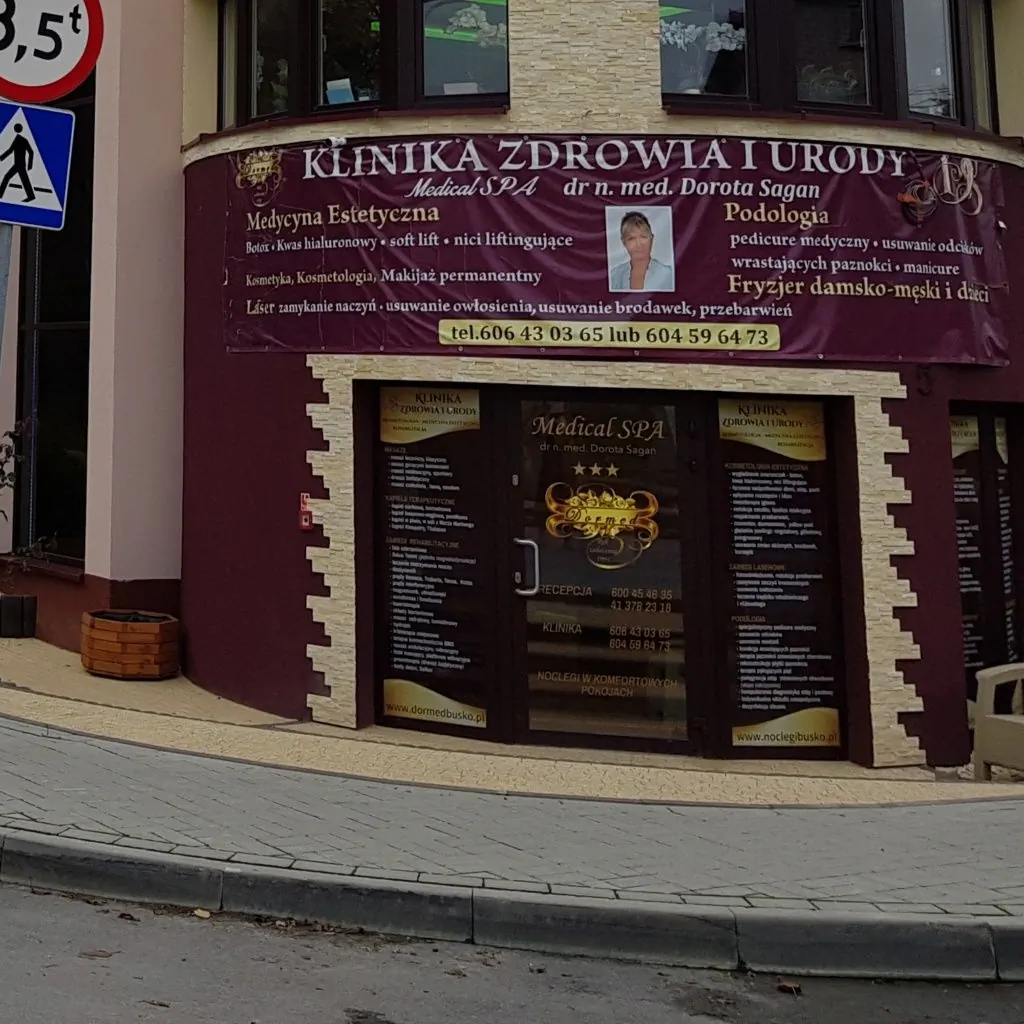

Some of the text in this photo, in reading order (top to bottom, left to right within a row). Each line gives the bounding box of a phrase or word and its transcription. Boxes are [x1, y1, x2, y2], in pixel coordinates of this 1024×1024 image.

[303, 139, 488, 179] KLINIKA
[498, 139, 732, 172] ZDROWIA
[740, 141, 759, 171] I
[766, 142, 907, 177] URODY
[404, 176, 820, 203] Medical SPA dr n. med. Dorota Sagan
[246, 204, 440, 234] Medycyna Estetyczna
[724, 202, 829, 230] Podologia
[246, 232, 573, 254] Botox Kwas hialuronowy soft lift nici liftingujące
[730, 232, 796, 249] pedicure
[800, 234, 870, 252] medyczny
[882, 238, 936, 252] usuwanie
[731, 256, 961, 275] wrastających paznokci manicure
[246, 269, 543, 288] Kosmetyka, Kosmetologia, Makijaż permanentny
[727, 274, 805, 301] Fryzjer
[810, 276, 942, 304] damsko-męski
[945, 281, 953, 299] i
[279, 300, 334, 316] zamykanie
[336, 298, 377, 316] naczyń
[386, 299, 451, 313] usuwanie
[453, 299, 536, 315] owłosienia,
[538, 301, 613, 314] usuwanie
[616, 301, 696, 317] brodawek,
[700, 302, 793, 319] przebarwień
[520, 326, 543, 340] 43
[550, 327, 573, 341] 03
[580, 327, 603, 342] 65
[610, 327, 640, 343] lub
[646, 328, 683, 343] 604
[689, 328, 711, 344] 59
[718, 329, 741, 345] 64
[746, 329, 768, 345] 73
[416, 392, 462, 404] KLINIKA
[531, 415, 665, 441] Medical SPA
[591, 444, 624, 454] Dorota
[626, 445, 656, 457] Sagan
[542, 622, 582, 634] KLINIKA
[386, 702, 485, 723] www.dormedbusko.pl
